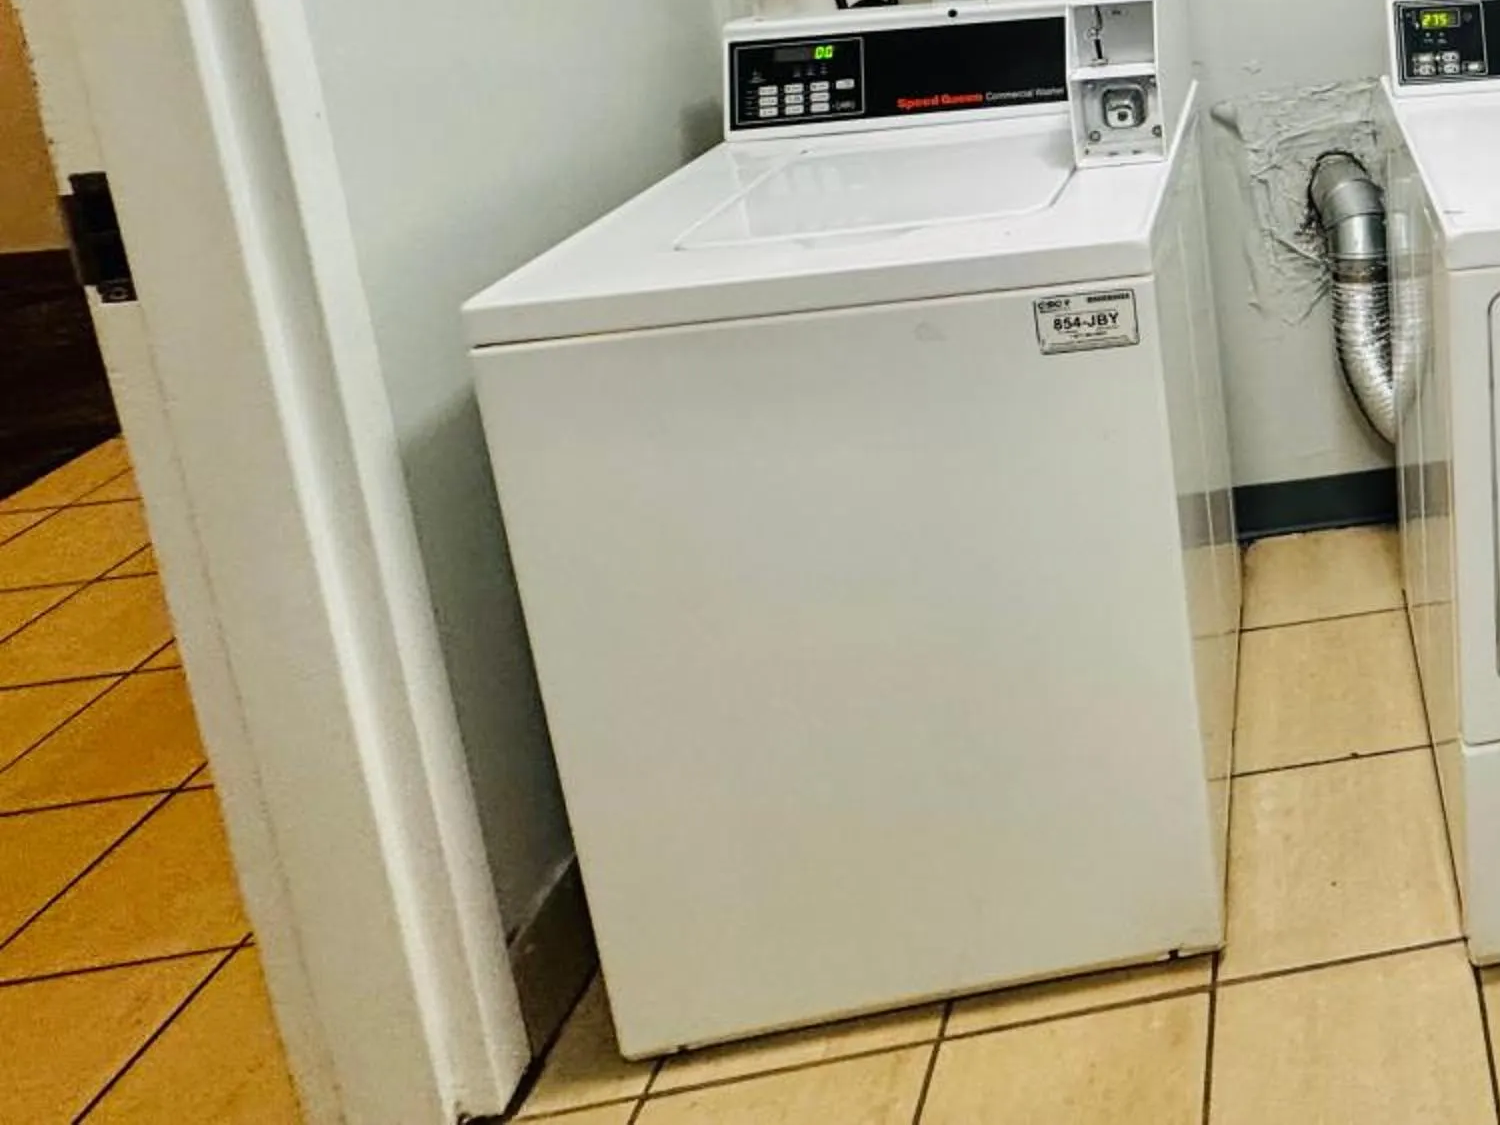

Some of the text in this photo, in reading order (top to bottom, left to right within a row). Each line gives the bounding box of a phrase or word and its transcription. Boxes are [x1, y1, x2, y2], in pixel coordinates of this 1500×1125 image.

[897, 95, 939, 110] Speed
[941, 92, 983, 105] Queen
[1053, 312, 1119, 331] 854-JBY
